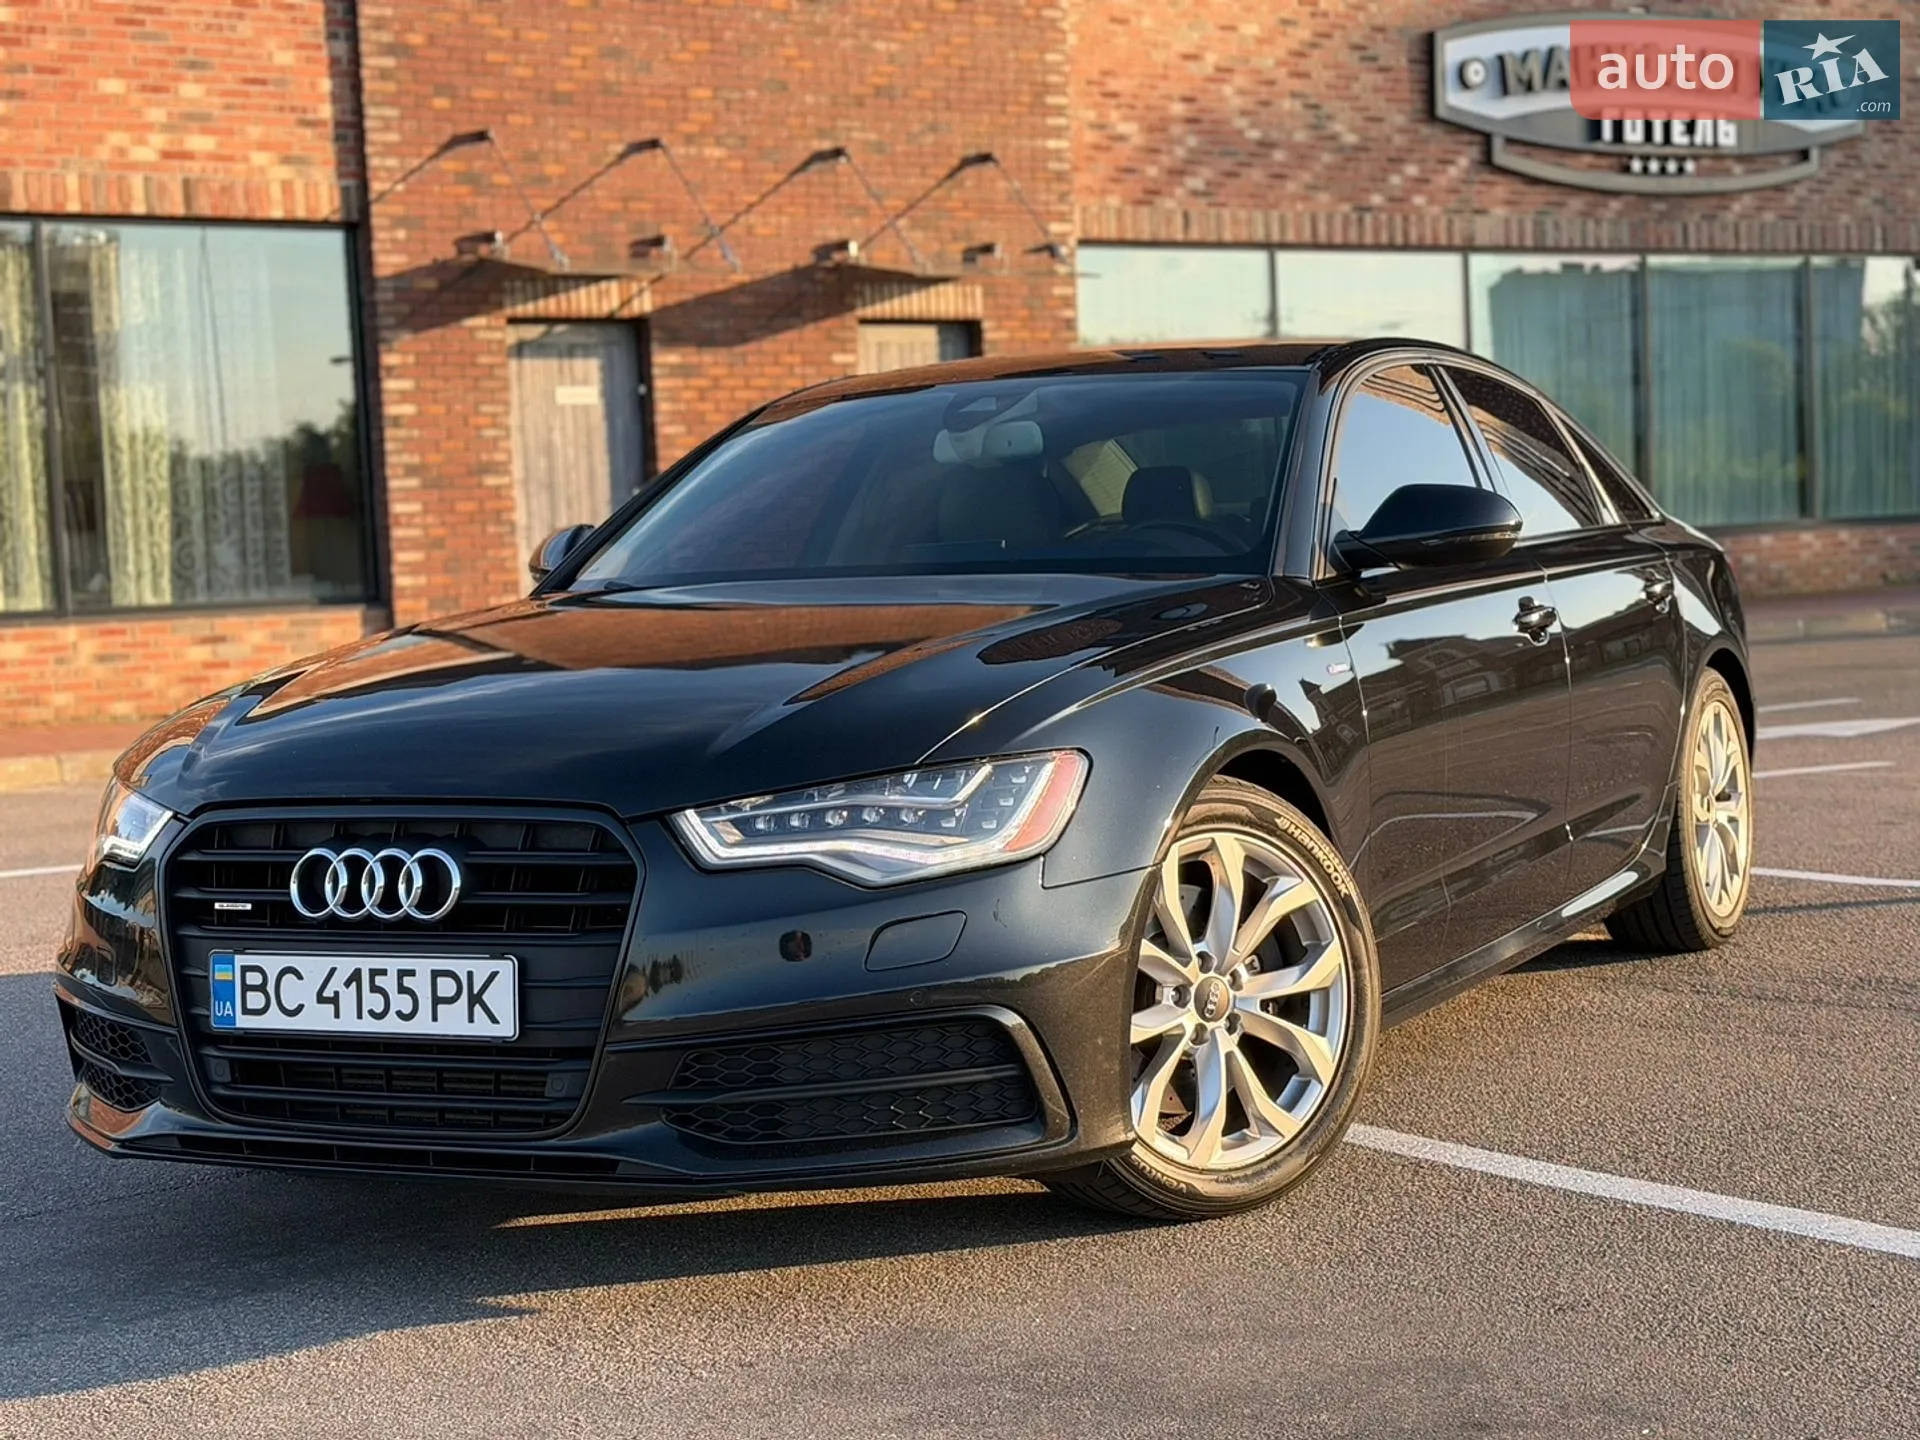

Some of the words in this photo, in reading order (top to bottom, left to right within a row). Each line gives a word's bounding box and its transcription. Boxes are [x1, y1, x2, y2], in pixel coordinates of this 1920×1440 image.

[214, 1000, 234, 1017] UA
[240, 964, 305, 1018] BC
[316, 966, 420, 1021] 4155
[430, 969, 501, 1025] PK
